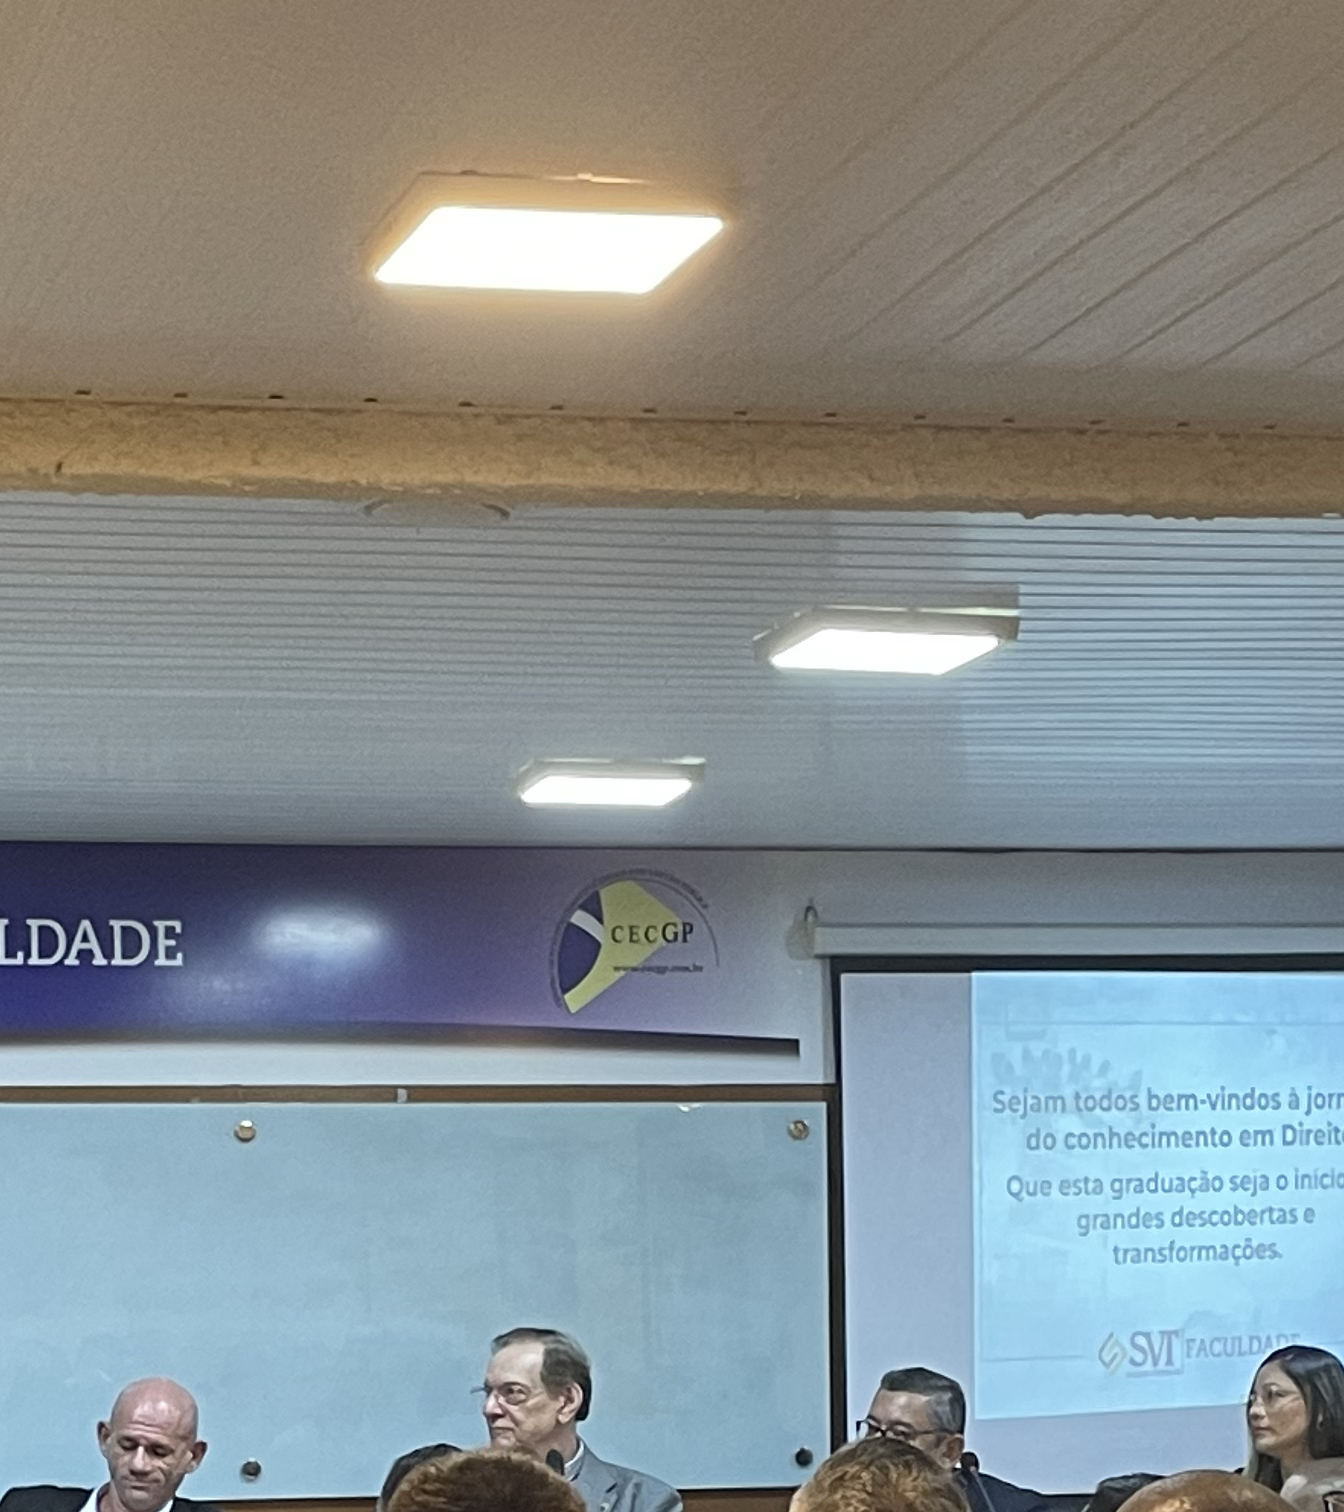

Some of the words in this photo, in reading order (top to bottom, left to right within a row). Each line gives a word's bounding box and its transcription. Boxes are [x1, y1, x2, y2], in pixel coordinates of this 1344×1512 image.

[610, 921, 695, 944] CECGP
[992, 1087, 1067, 1120] Sejam
[1074, 1088, 1140, 1113] todos
[1146, 1085, 1282, 1112] bem-vindos
[1026, 1127, 1057, 1151] do
[1064, 1123, 1233, 1151] conhecimento
[1239, 1128, 1275, 1148] em
[1006, 1174, 1053, 1203] Que
[1058, 1176, 1104, 1197] esta
[1110, 1169, 1224, 1201] graduação
[1229, 1167, 1270, 1198] seja
[1276, 1173, 1289, 1191] o
[1077, 1206, 1165, 1237] grandes
[1171, 1204, 1299, 1229] descobertas
[1303, 1206, 1316, 1225] e
[1112, 1237, 1284, 1268] transformações.
[1128, 1329, 1179, 1368] SVT
